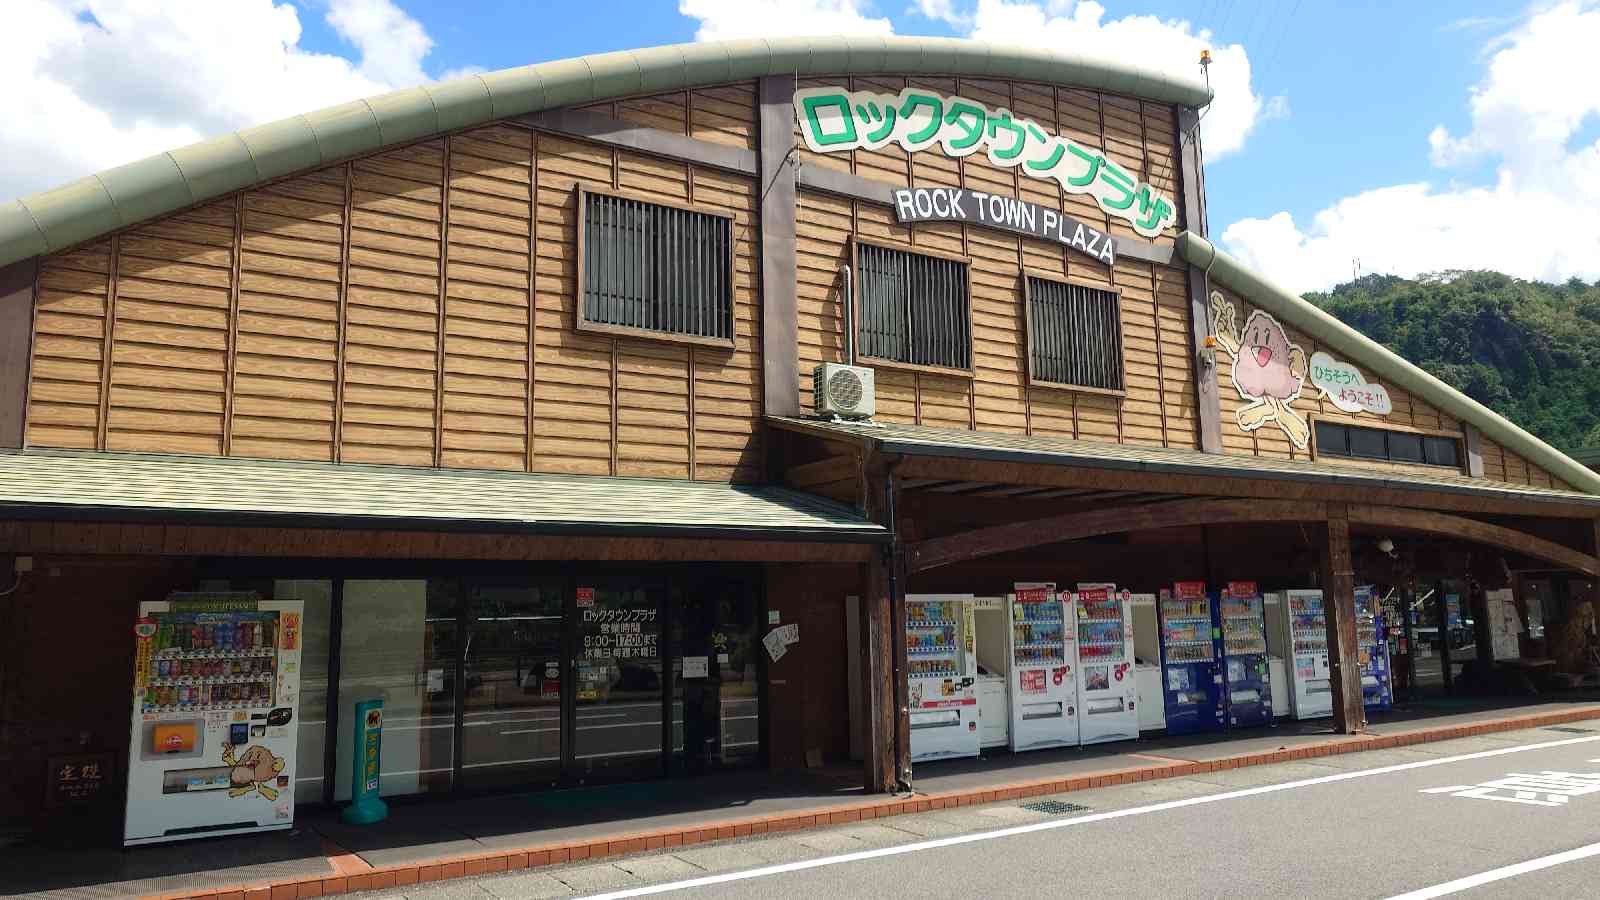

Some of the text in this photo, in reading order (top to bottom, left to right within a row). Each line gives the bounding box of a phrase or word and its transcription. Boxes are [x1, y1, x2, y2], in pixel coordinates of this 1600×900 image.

[803, 94, 1173, 231] ロックタウンプラザ
[898, 190, 1115, 265] ROCK TOWN PLAZA
[583, 608, 657, 622] ロックタウンプラザ
[600, 622, 641, 633] 営業時間
